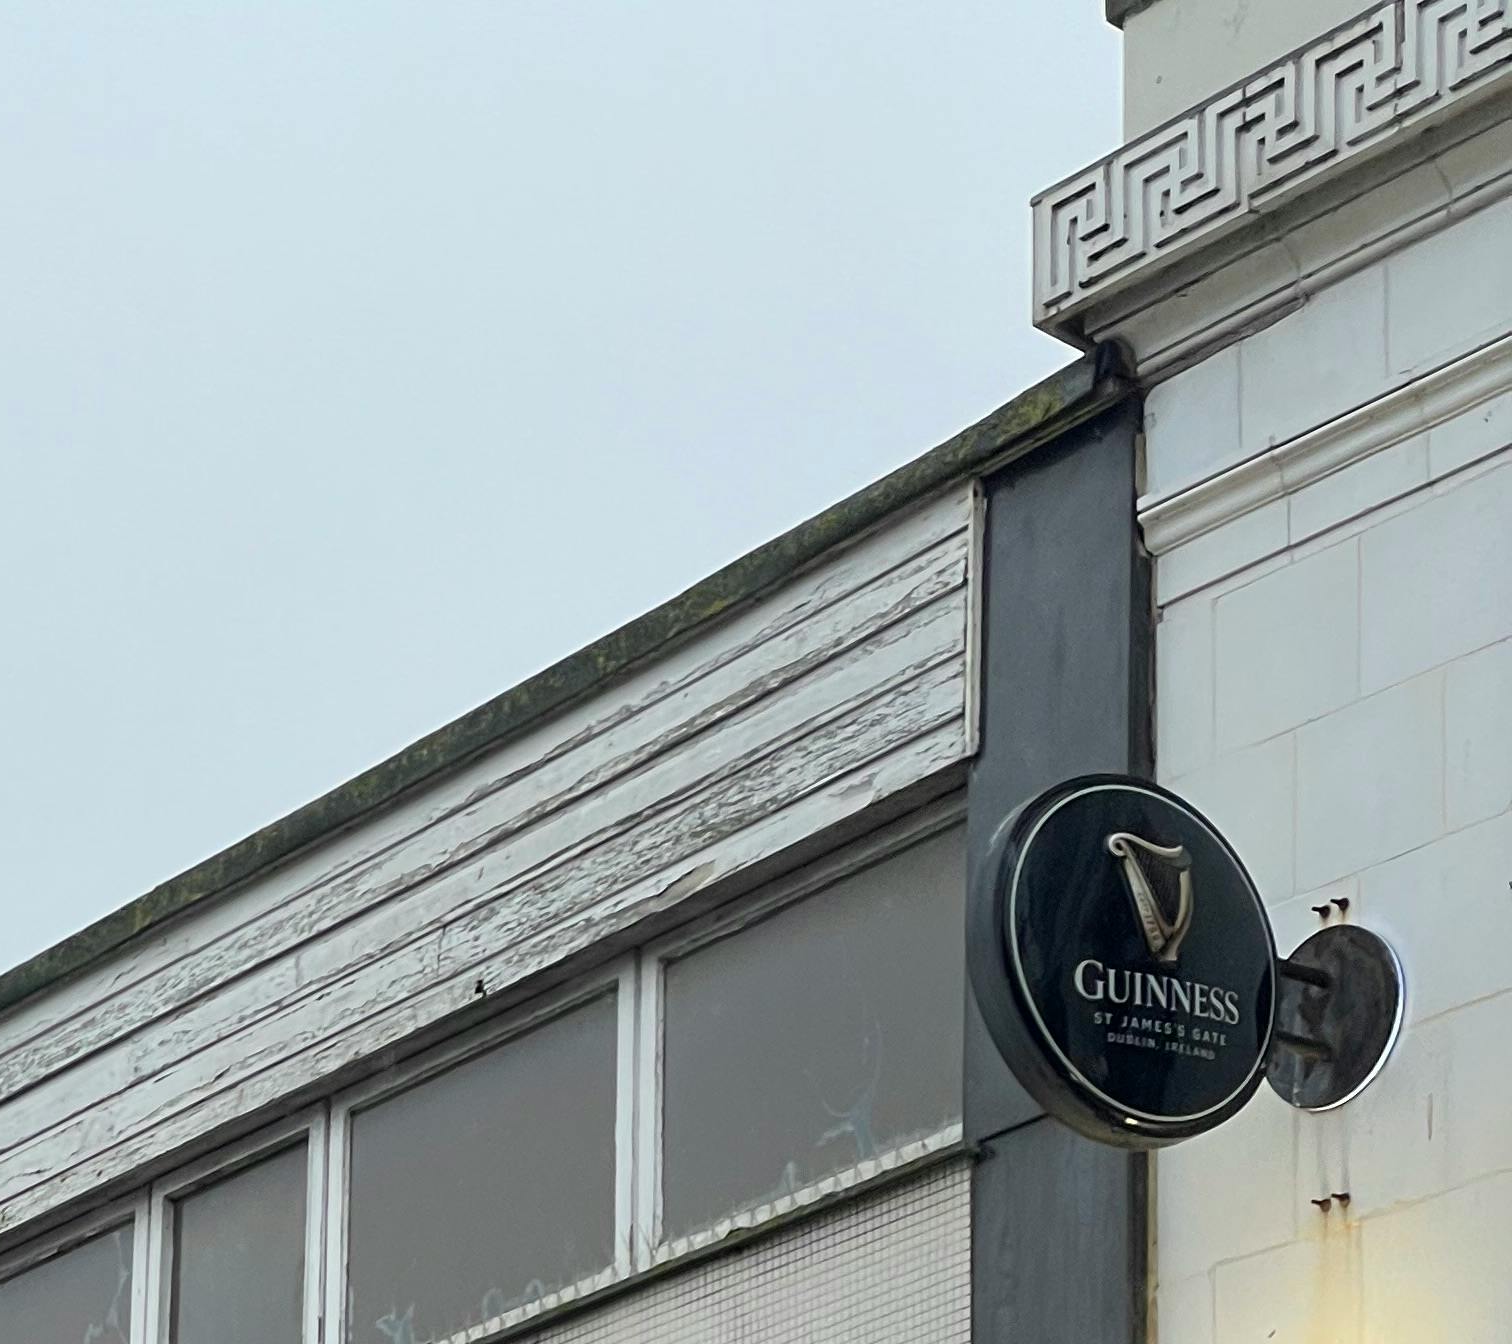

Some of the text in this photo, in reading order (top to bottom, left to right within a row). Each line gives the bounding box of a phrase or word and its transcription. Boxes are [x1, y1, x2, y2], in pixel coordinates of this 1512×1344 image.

[1074, 959, 1240, 1025] GUINNESS
[1093, 1011, 1227, 1046] ST JAMES'S GATE
[1164, 1041, 1216, 1060] IRELAND
